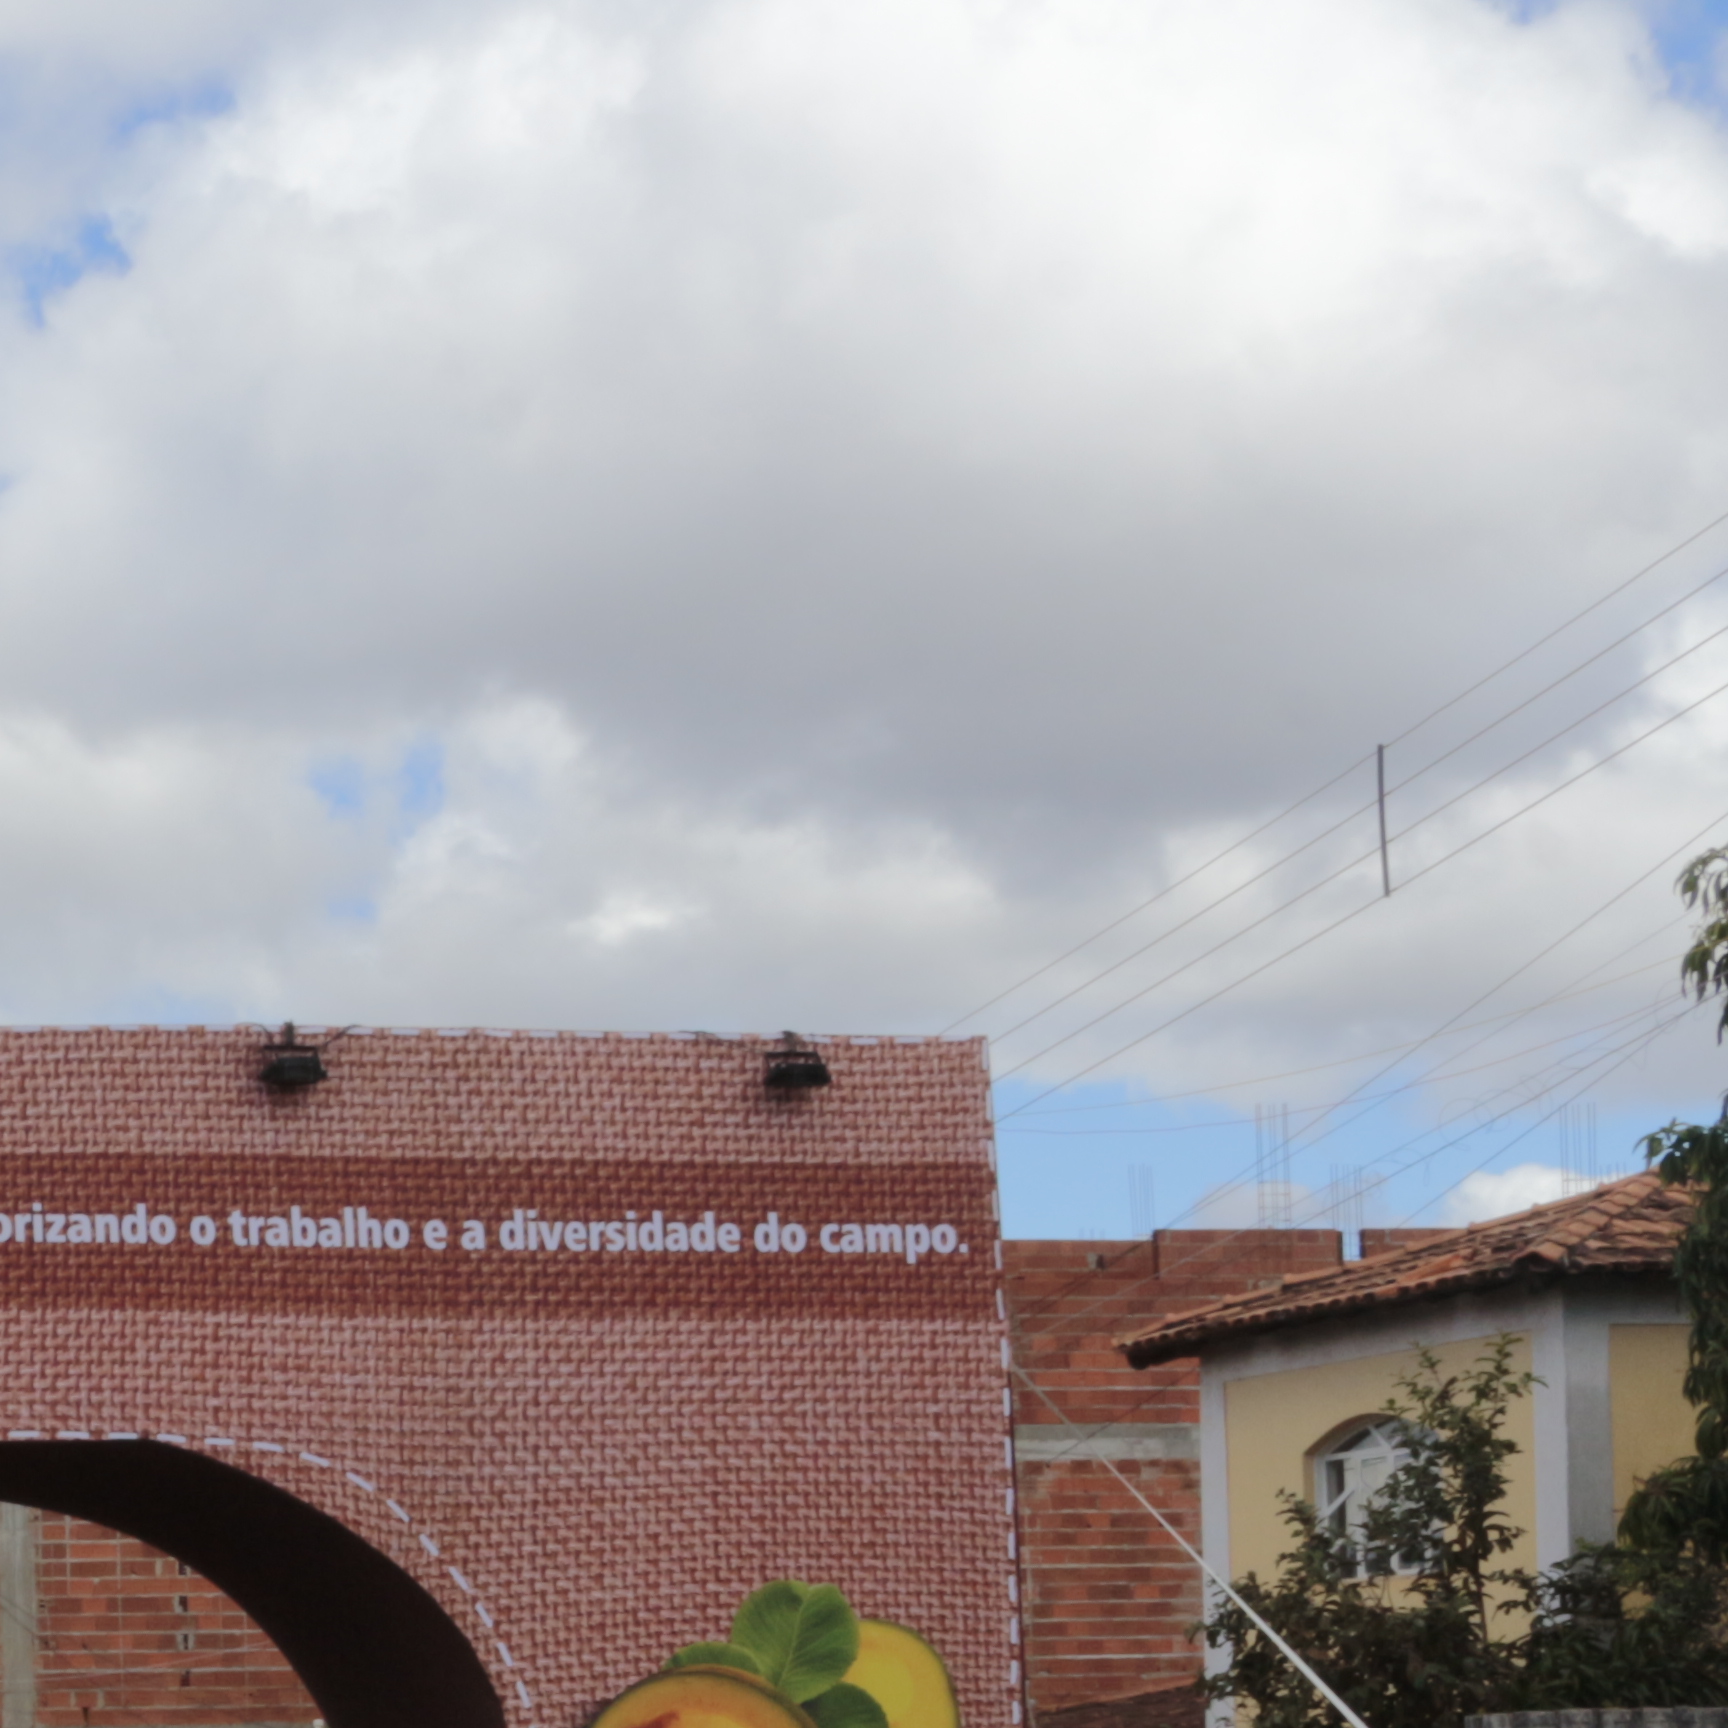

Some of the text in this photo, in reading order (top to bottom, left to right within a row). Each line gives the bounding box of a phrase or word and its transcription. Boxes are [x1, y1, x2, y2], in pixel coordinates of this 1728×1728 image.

[189, 1215, 217, 1246] o
[227, 1206, 410, 1250] trabalho
[423, 1219, 448, 1250] e
[460, 1219, 486, 1251] a
[499, 1208, 741, 1253] diversidade
[753, 1211, 807, 1253] do
[819, 1223, 969, 1264] campo.
